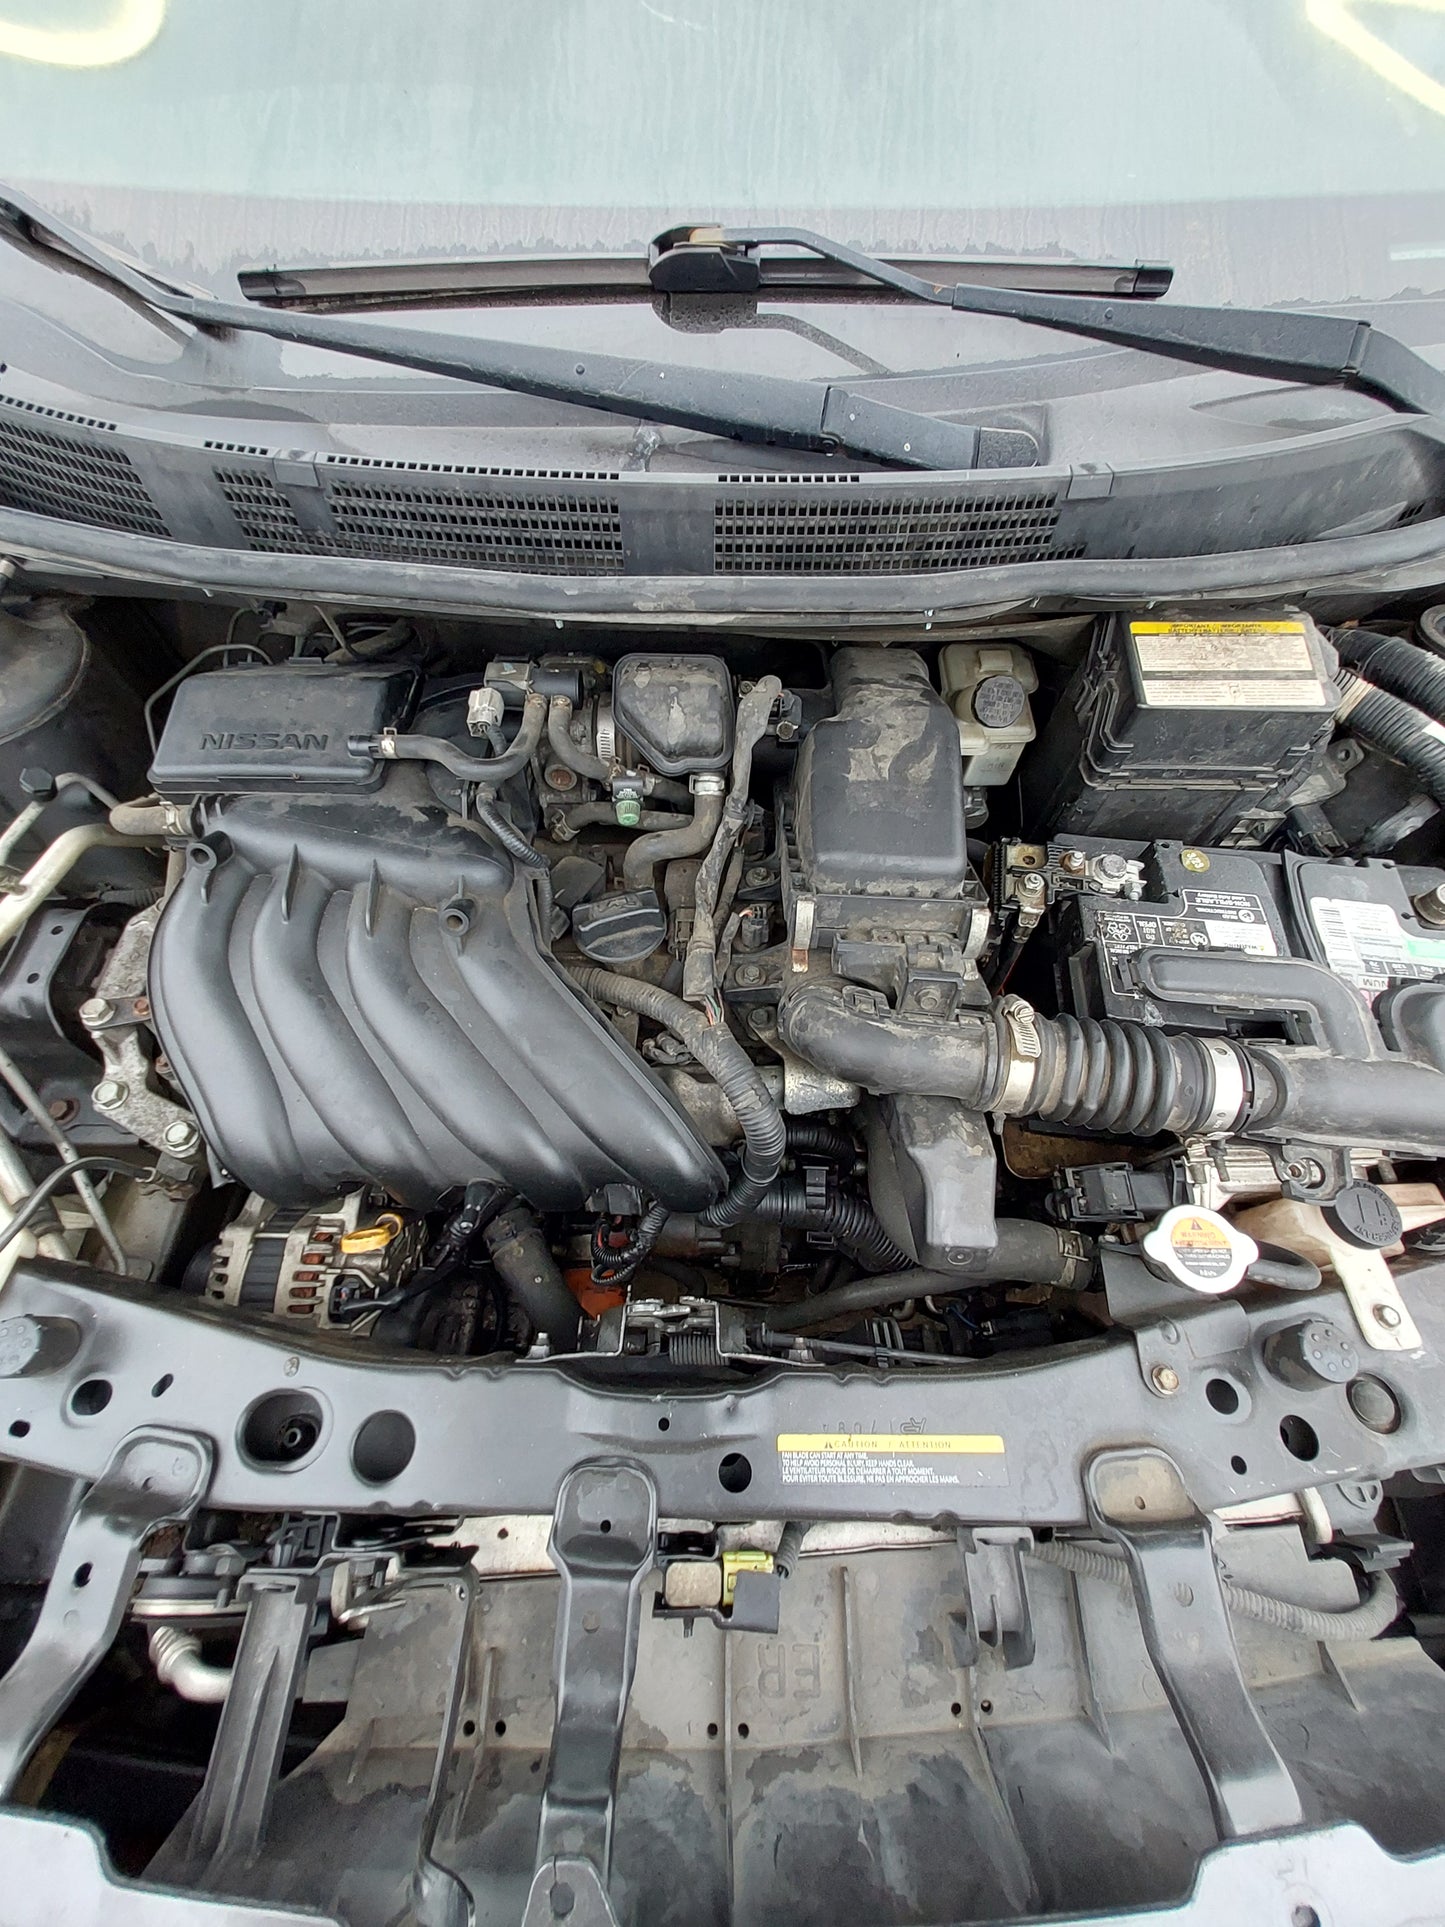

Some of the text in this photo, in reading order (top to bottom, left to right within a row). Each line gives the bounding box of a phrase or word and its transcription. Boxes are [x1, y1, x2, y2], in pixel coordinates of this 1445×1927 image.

[201, 733, 330, 750] NISSAN
[783, 1474, 798, 1482] POUR
[818, 1475, 836, 1483] TOUTE
[875, 1475, 885, 1483] PAS
[886, 1475, 894, 1483] EN
